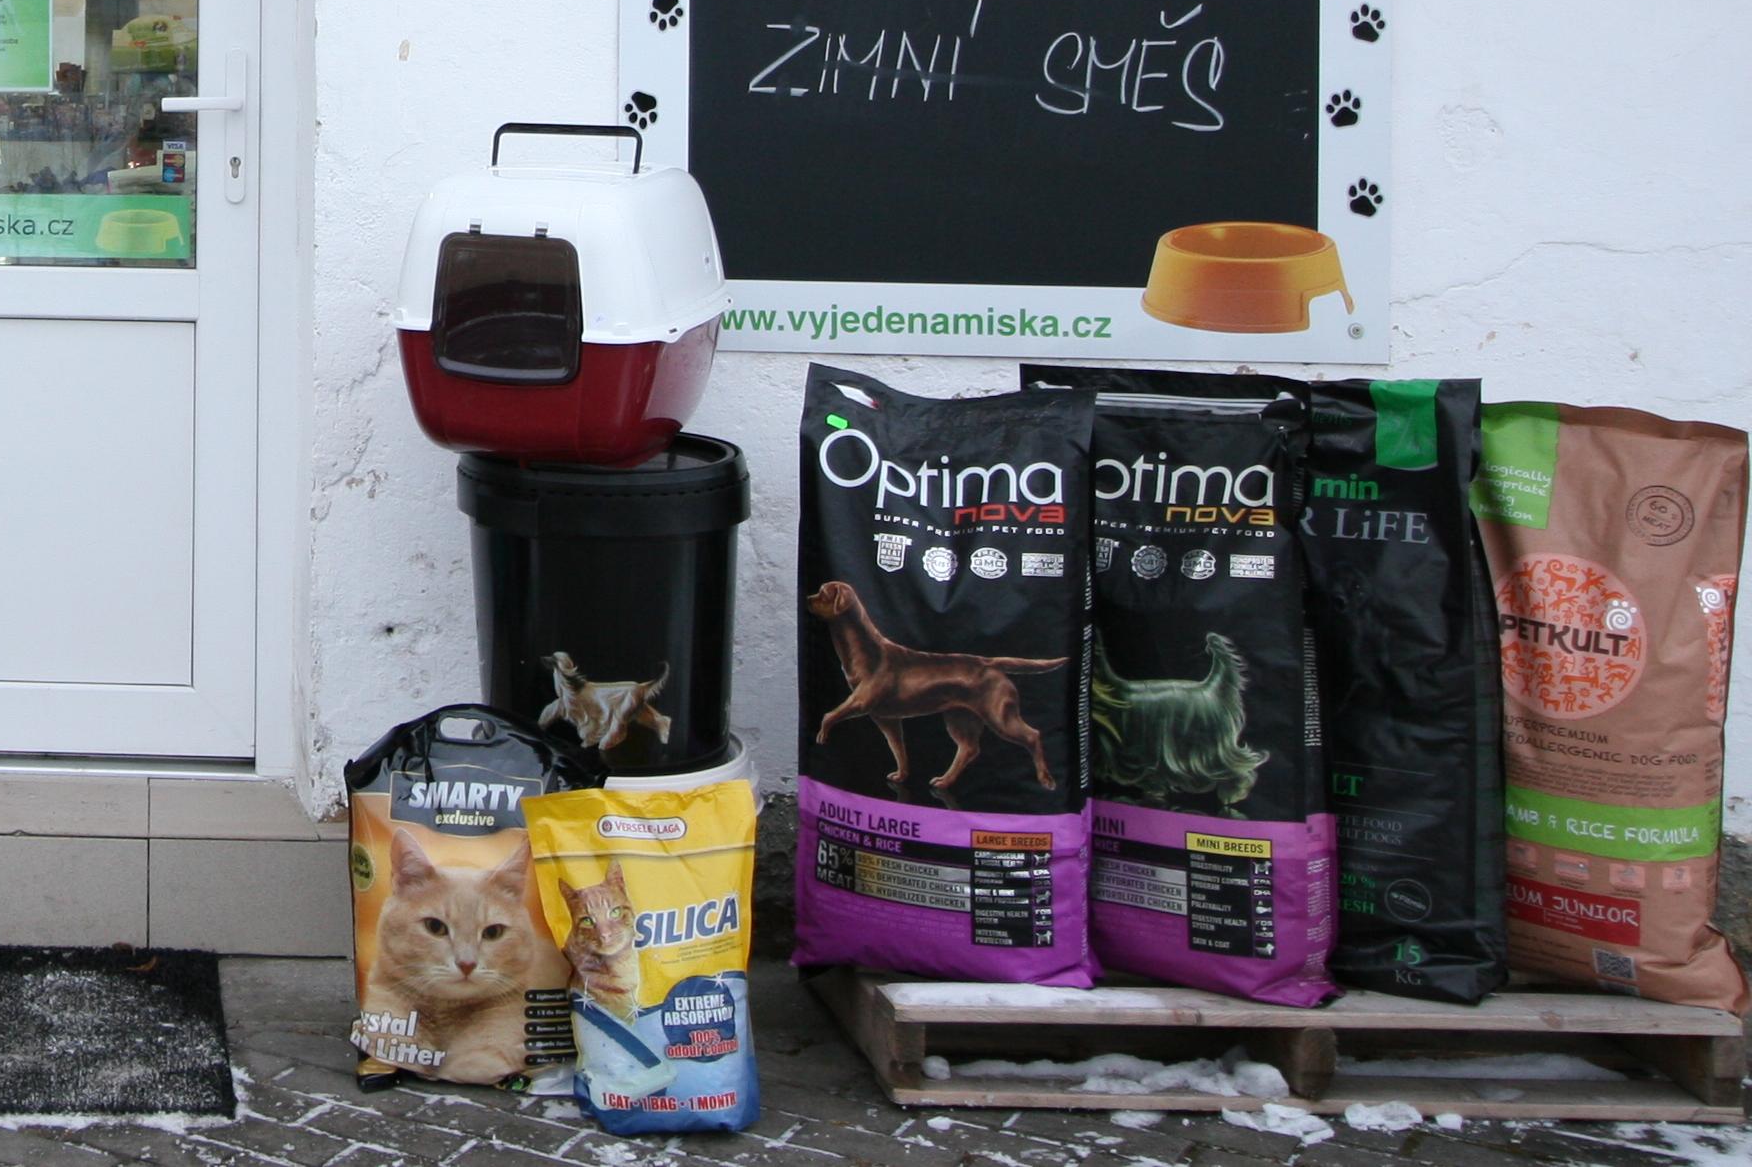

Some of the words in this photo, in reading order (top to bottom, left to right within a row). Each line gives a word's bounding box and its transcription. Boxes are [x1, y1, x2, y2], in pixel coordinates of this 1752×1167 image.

[1035, 3, 1225, 131] SMĚS
[166, 143, 185, 151] VISA
[721, 304, 1111, 341] ww.vyjedenamiska.cz
[819, 428, 1064, 509] Optima
[1096, 451, 1275, 508] ptima
[1486, 462, 1552, 489] logically
[1313, 473, 1379, 501] min
[874, 513, 920, 528] SUPER
[926, 524, 985, 538] PREMIUM
[992, 525, 1018, 535] PET
[1026, 527, 1066, 536] FOOD
[954, 504, 1066, 525] nova
[1166, 506, 1276, 526] nova
[1332, 507, 1430, 545] LiFE
[1135, 524, 1197, 534] PREMIUM
[1203, 527, 1228, 536] PET
[1236, 529, 1276, 539] FOOD
[973, 559, 1004, 568] GMO
[1499, 613, 1629, 658] PETKULT
[1504, 716, 1610, 745] UPERPREMIUM
[1629, 754, 1663, 767] DOG
[408, 782, 524, 812] SMARTY
[435, 810, 495, 827] exclusive
[615, 820, 682, 835] VERSELE-LAGA
[819, 800, 863, 827] ADULT
[868, 813, 921, 839] LARGE
[1506, 803, 1541, 827] AMB
[1565, 817, 1617, 841] RICE
[1623, 826, 1700, 846] FORMULA
[818, 820, 861, 844] CHICKEN
[862, 836, 873, 848] &
[875, 837, 902, 853] RICE
[975, 834, 1009, 847] LARGE
[1010, 837, 1048, 848] BREEDS
[1196, 837, 1220, 849] MINI
[1223, 841, 1264, 854] BREEDS
[817, 839, 854, 869] 65%
[817, 867, 854, 890] MEAT
[876, 856, 903, 871] FRESH
[903, 863, 940, 877] CHICKEN
[876, 872, 927, 891] DEHYDRATED
[876, 885, 927, 904] HYDROLIZED
[929, 895, 967, 909] CHICKEN
[1147, 896, 1183, 912] CHICKEN
[633, 895, 741, 950] SILICA
[1551, 895, 1640, 927] JUNIOR
[1394, 942, 1423, 966] 15
[1395, 969, 1422, 985] KG
[674, 994, 726, 1011] EXTREME
[664, 1005, 735, 1026] ABSORPTION
[375, 1037, 446, 1067] Litter
[664, 1041, 704, 1059] odour
[608, 1093, 631, 1110] CAT
[650, 1096, 678, 1111] BAG
[697, 1091, 738, 1111] MONTH
